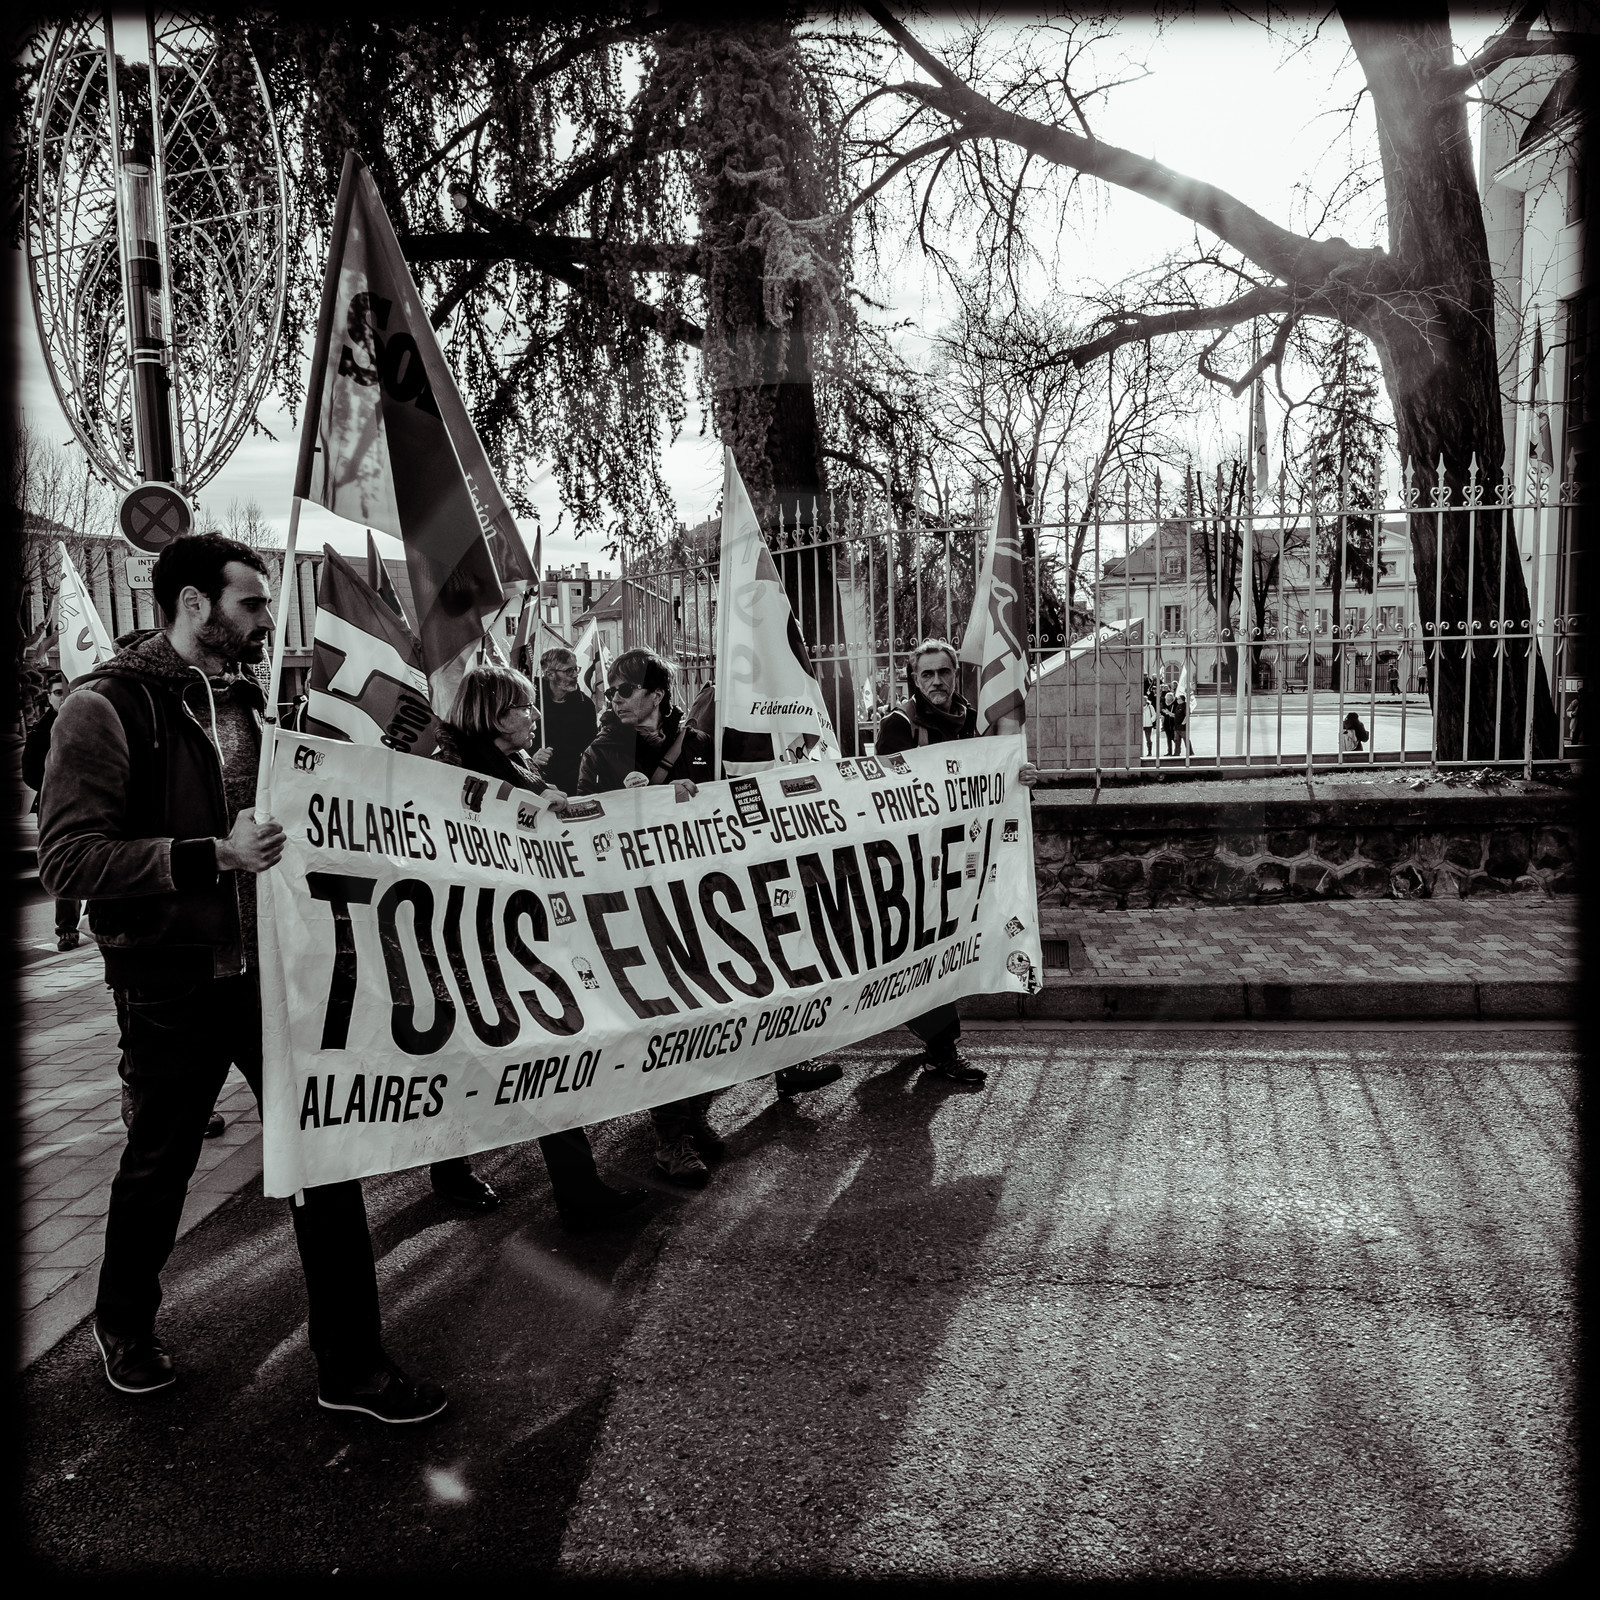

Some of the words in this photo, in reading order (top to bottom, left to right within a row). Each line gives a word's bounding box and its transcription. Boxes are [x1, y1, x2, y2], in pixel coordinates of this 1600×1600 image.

[750, 700, 813, 716] Fédération
[861, 760, 878, 775] FO
[306, 793, 437, 860] SALARIÉS
[618, 808, 746, 871] RETRAITÉS
[769, 799, 847, 844] JEUNES
[871, 777, 940, 824] PRIVÉS
[944, 772, 1005, 812] D'EMPLOI
[1003, 831, 1020, 842] cgt
[551, 897, 567, 918] FO
[305, 871, 585, 1055] TOUS
[582, 824, 966, 1019] ENSEMBLE
[494, 1049, 602, 1106] EMPLOI
[641, 1017, 747, 1073] SERVICES
[751, 996, 832, 1046] PUBLICS
[854, 954, 937, 1015] PROTECTION
